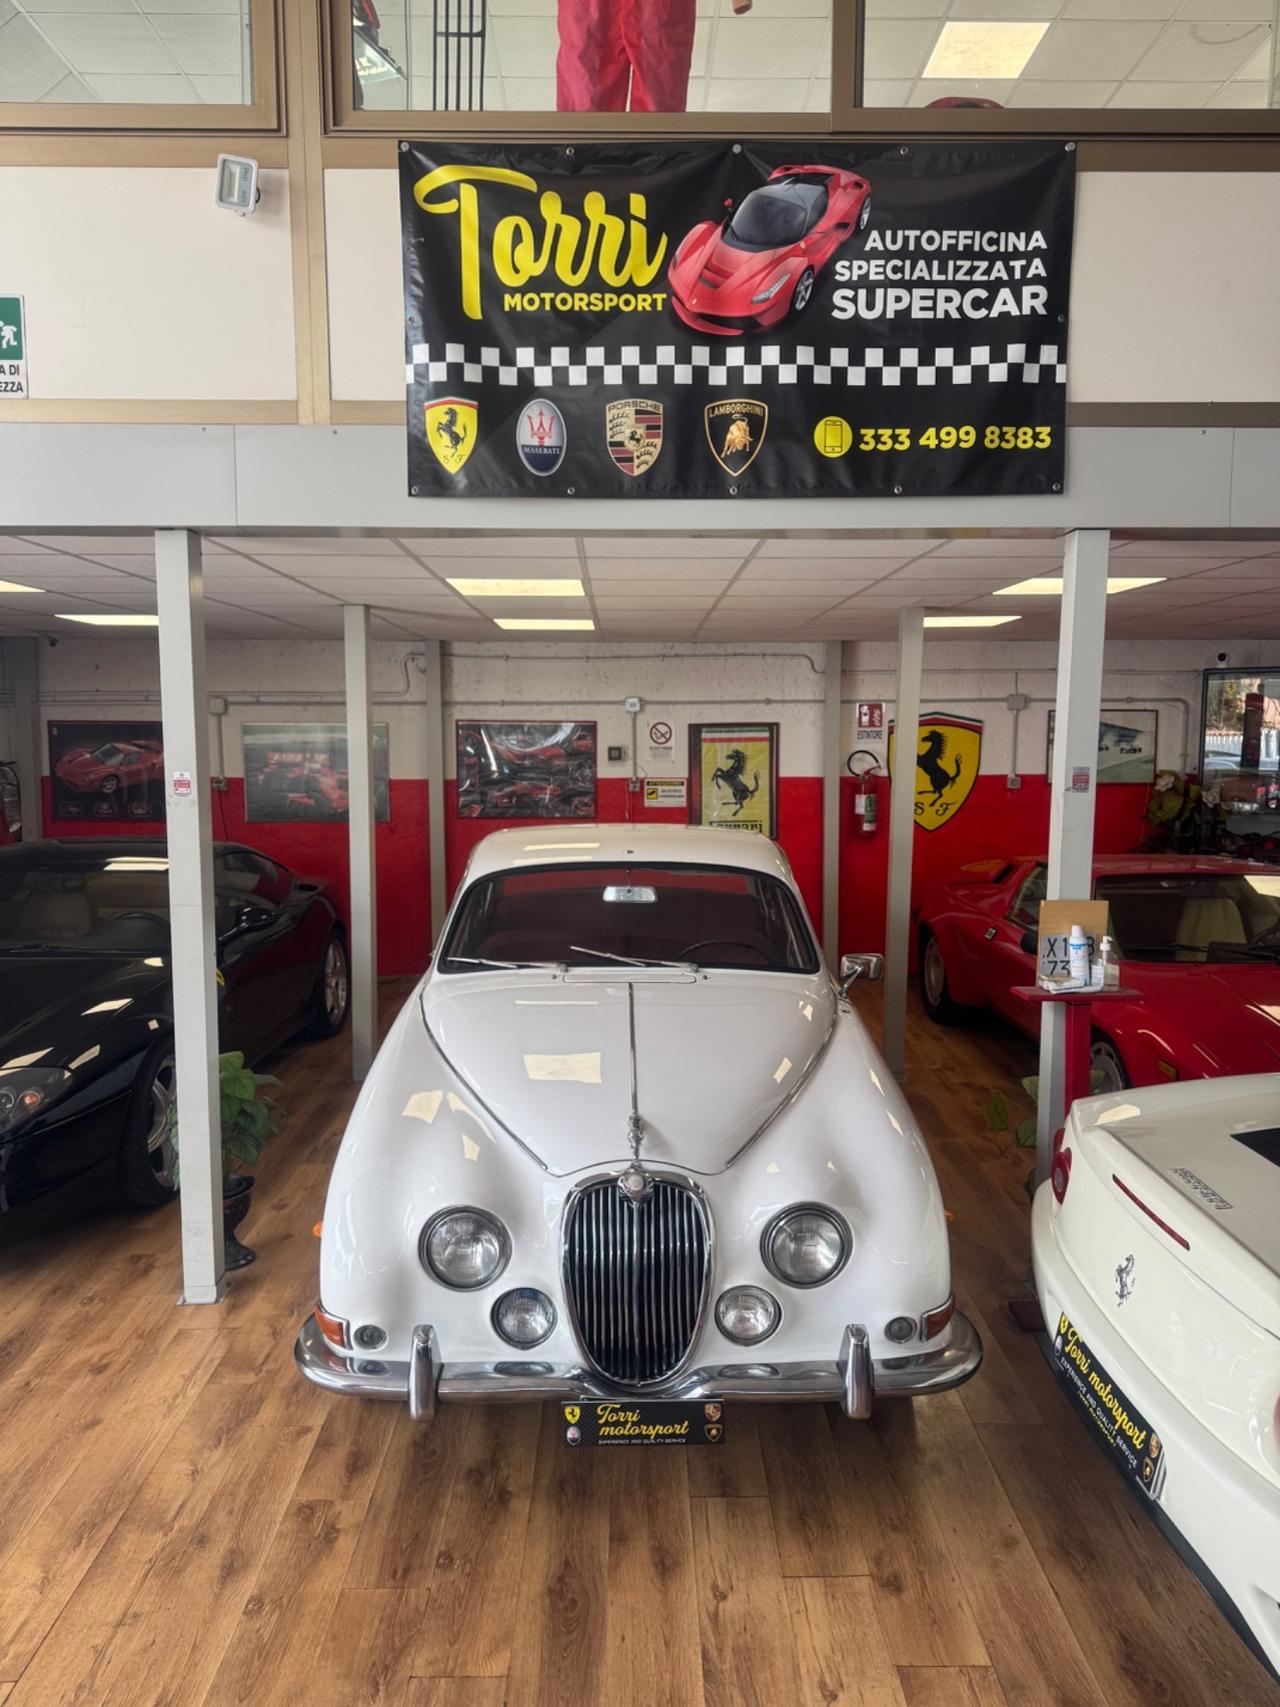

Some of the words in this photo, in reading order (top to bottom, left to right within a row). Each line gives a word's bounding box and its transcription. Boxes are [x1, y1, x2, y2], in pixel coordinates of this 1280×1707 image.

[414, 164, 668, 319] Torri
[864, 229, 1048, 252] AUTOFFICINA
[834, 257, 1048, 282] SPECIALIZZATA
[503, 292, 667, 313] MOTORSPORT
[831, 285, 1049, 320] SUPERCAR
[9, 364, 19, 375] DI
[607, 400, 662, 412] PORSCHE
[709, 404, 763, 418] LAMBORGHINI
[859, 428, 911, 451] 333
[919, 426, 976, 449] 499
[984, 426, 1052, 449] 8383
[523, 445, 561, 455] MASERATI
[1065, 1327, 1091, 1375] Torri
[1088, 1371, 1147, 1450] motorsport
[596, 1403, 641, 1424] Torri
[1060, 1356, 1087, 1395] EXPERIENCE
[1096, 1407, 1117, 1437] QUALITY
[1116, 1435, 1138, 1469] SERVICE
[599, 1420, 690, 1440] motorsport
